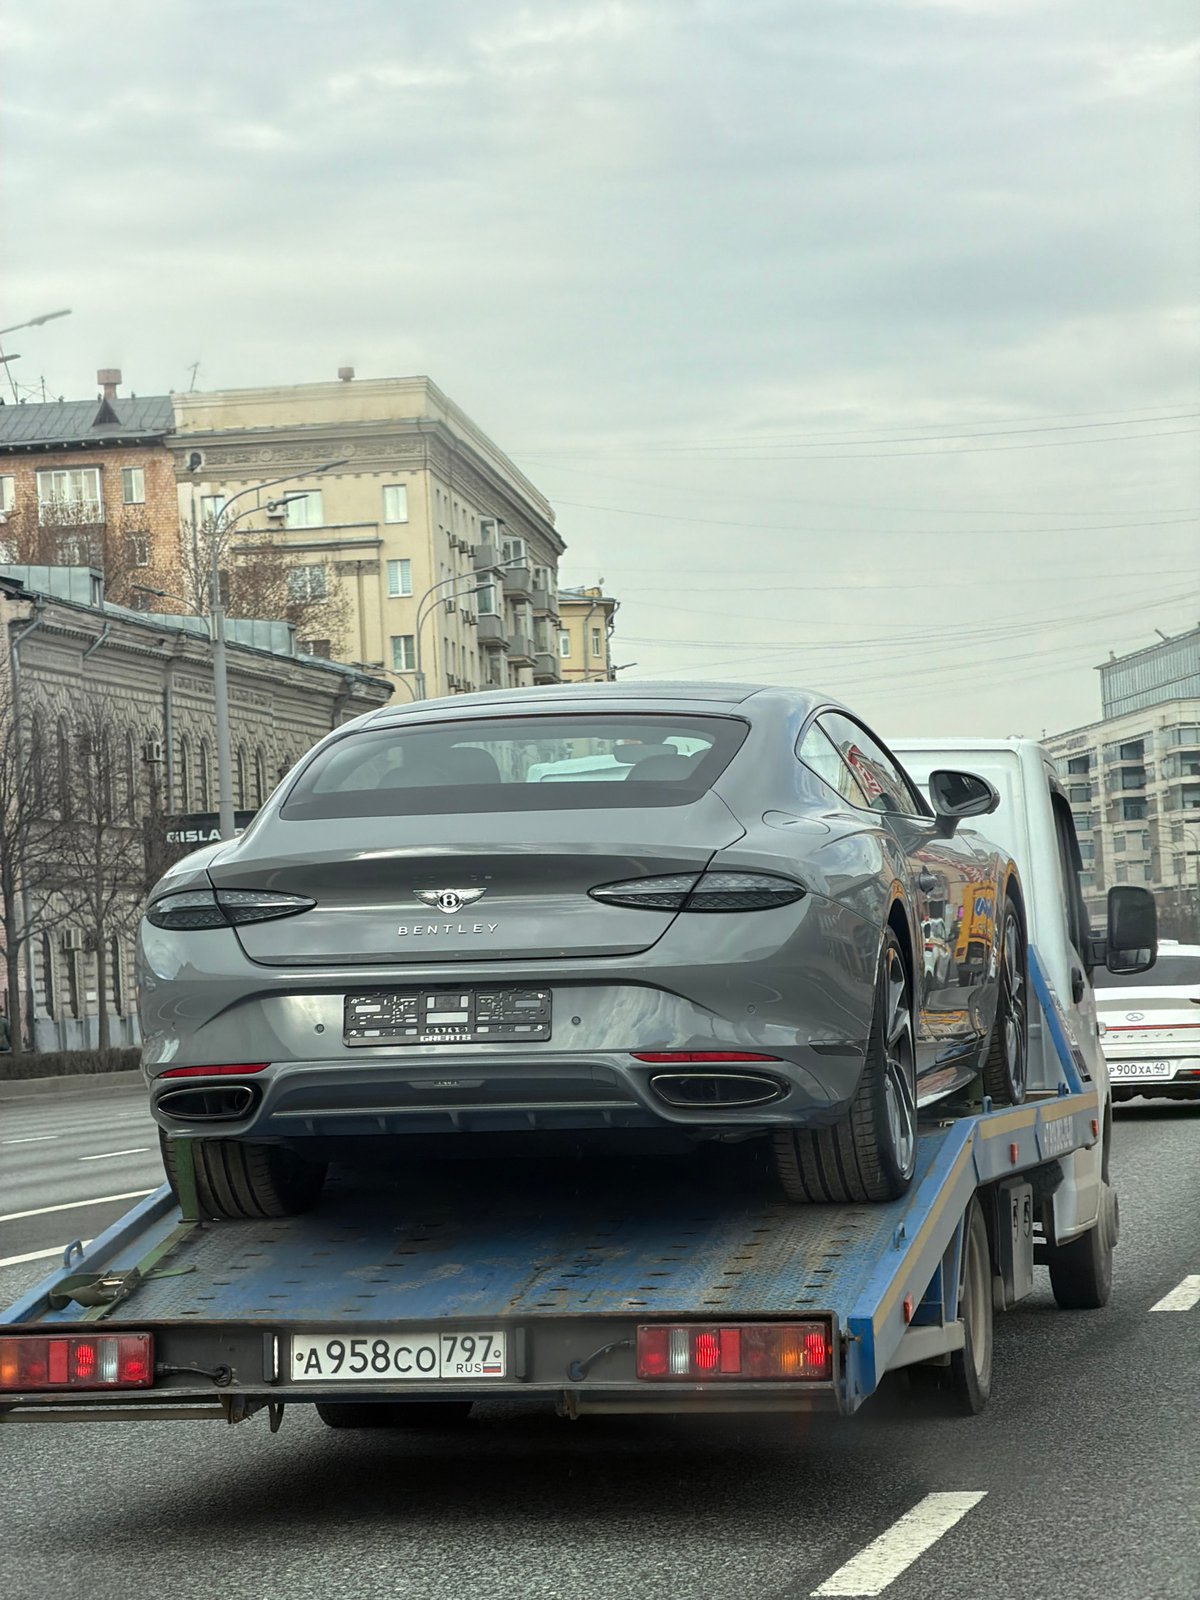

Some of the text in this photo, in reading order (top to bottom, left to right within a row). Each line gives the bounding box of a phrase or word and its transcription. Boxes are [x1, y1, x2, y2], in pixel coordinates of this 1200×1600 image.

[398, 923, 498, 936] BENTLEY
[442, 1335, 494, 1363] 797
[456, 1362, 482, 1373] RUS
